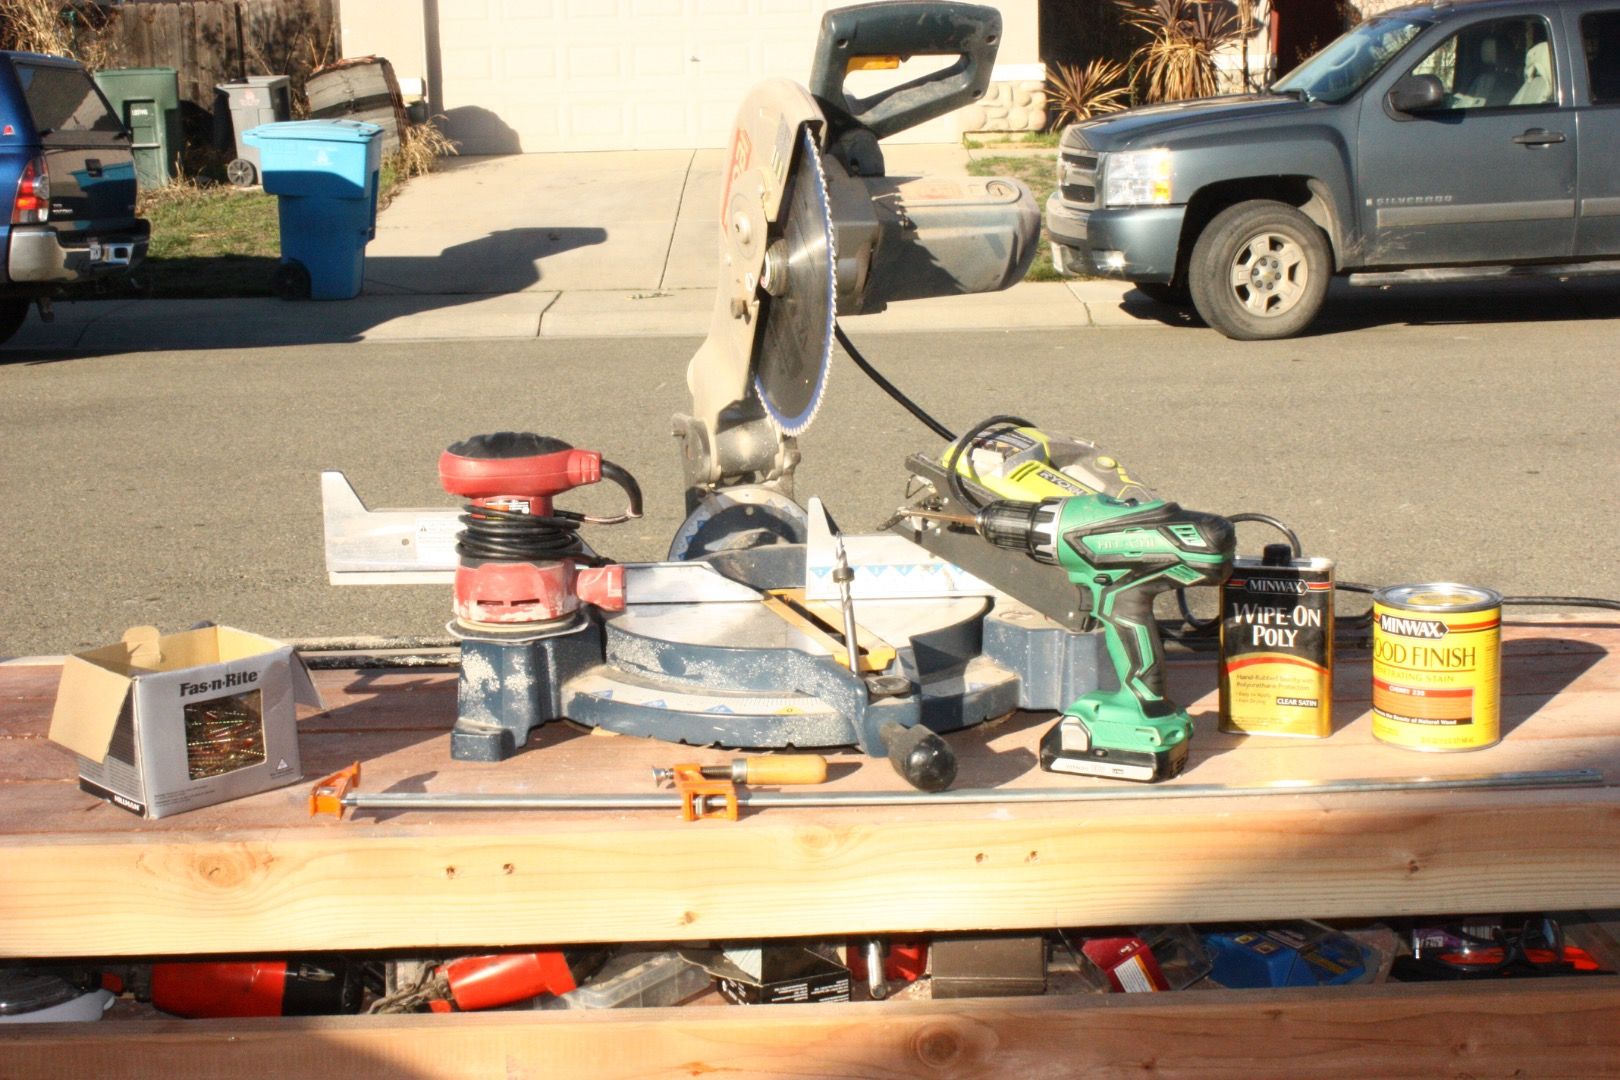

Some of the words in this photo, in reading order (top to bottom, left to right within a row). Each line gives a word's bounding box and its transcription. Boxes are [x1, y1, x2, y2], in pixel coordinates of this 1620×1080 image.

[1376, 195, 1453, 206] SILVERADO
[1249, 579, 1303, 593] MINWAX
[1232, 602, 1321, 627] WIPE-ON
[1252, 625, 1299, 648] POLY
[1374, 638, 1407, 663] OOD
[1412, 646, 1476, 668] FINISH
[1276, 698, 1297, 706] CLEAR
[1298, 699, 1317, 708] SATIN
